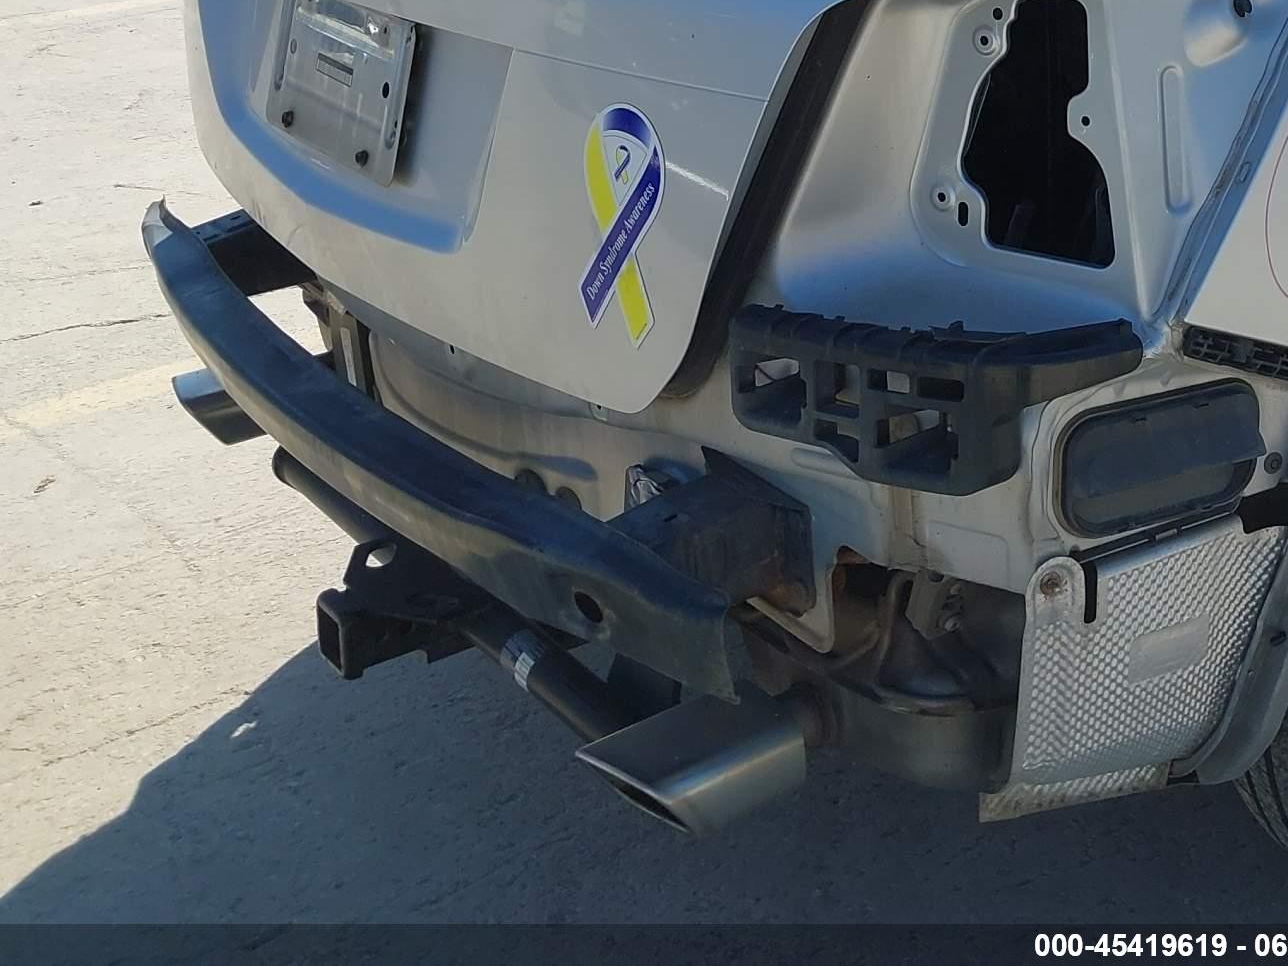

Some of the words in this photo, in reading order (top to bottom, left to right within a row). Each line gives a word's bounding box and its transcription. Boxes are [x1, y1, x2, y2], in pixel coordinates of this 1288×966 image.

[587, 273, 605, 300] Down
[600, 229, 628, 274] Syndrome
[624, 183, 655, 234] Awareness
